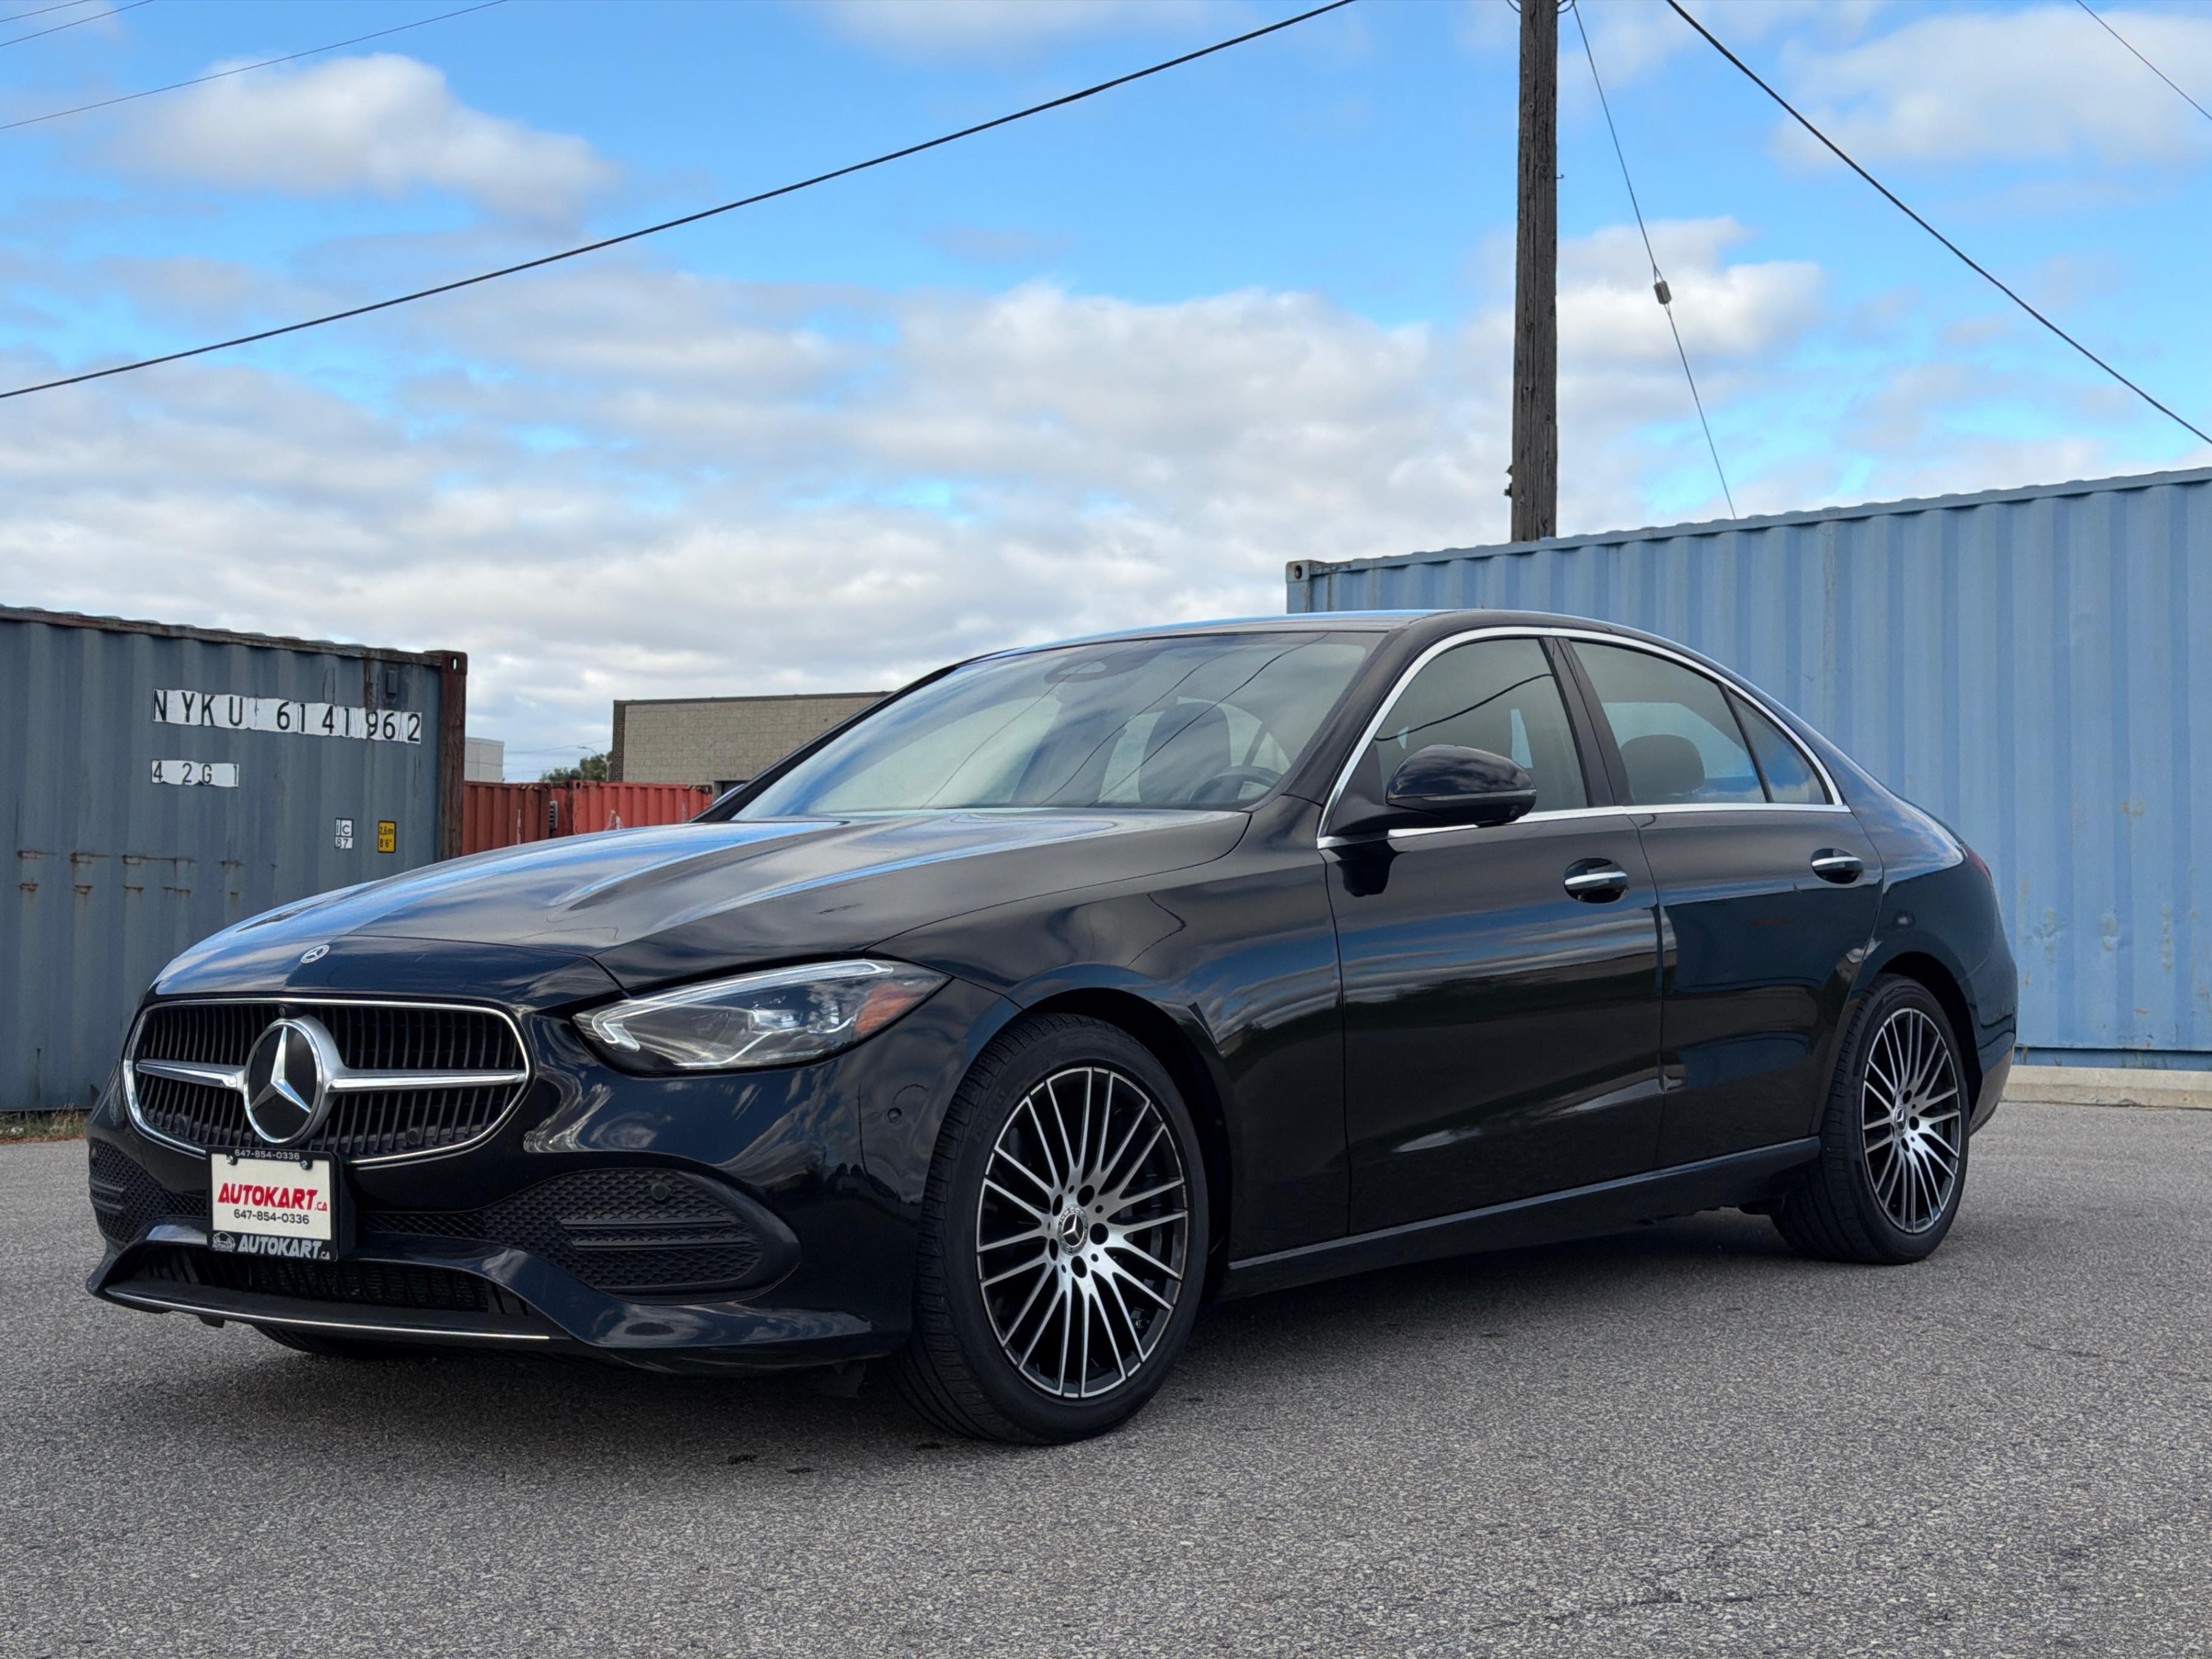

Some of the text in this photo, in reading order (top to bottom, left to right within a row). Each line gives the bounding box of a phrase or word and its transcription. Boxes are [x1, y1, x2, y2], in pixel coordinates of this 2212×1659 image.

[153, 689, 420, 741] NYKU 6141962
[235, 1149, 300, 1160] 647-854-0336
[233, 1209, 309, 1224] 647-854-0336
